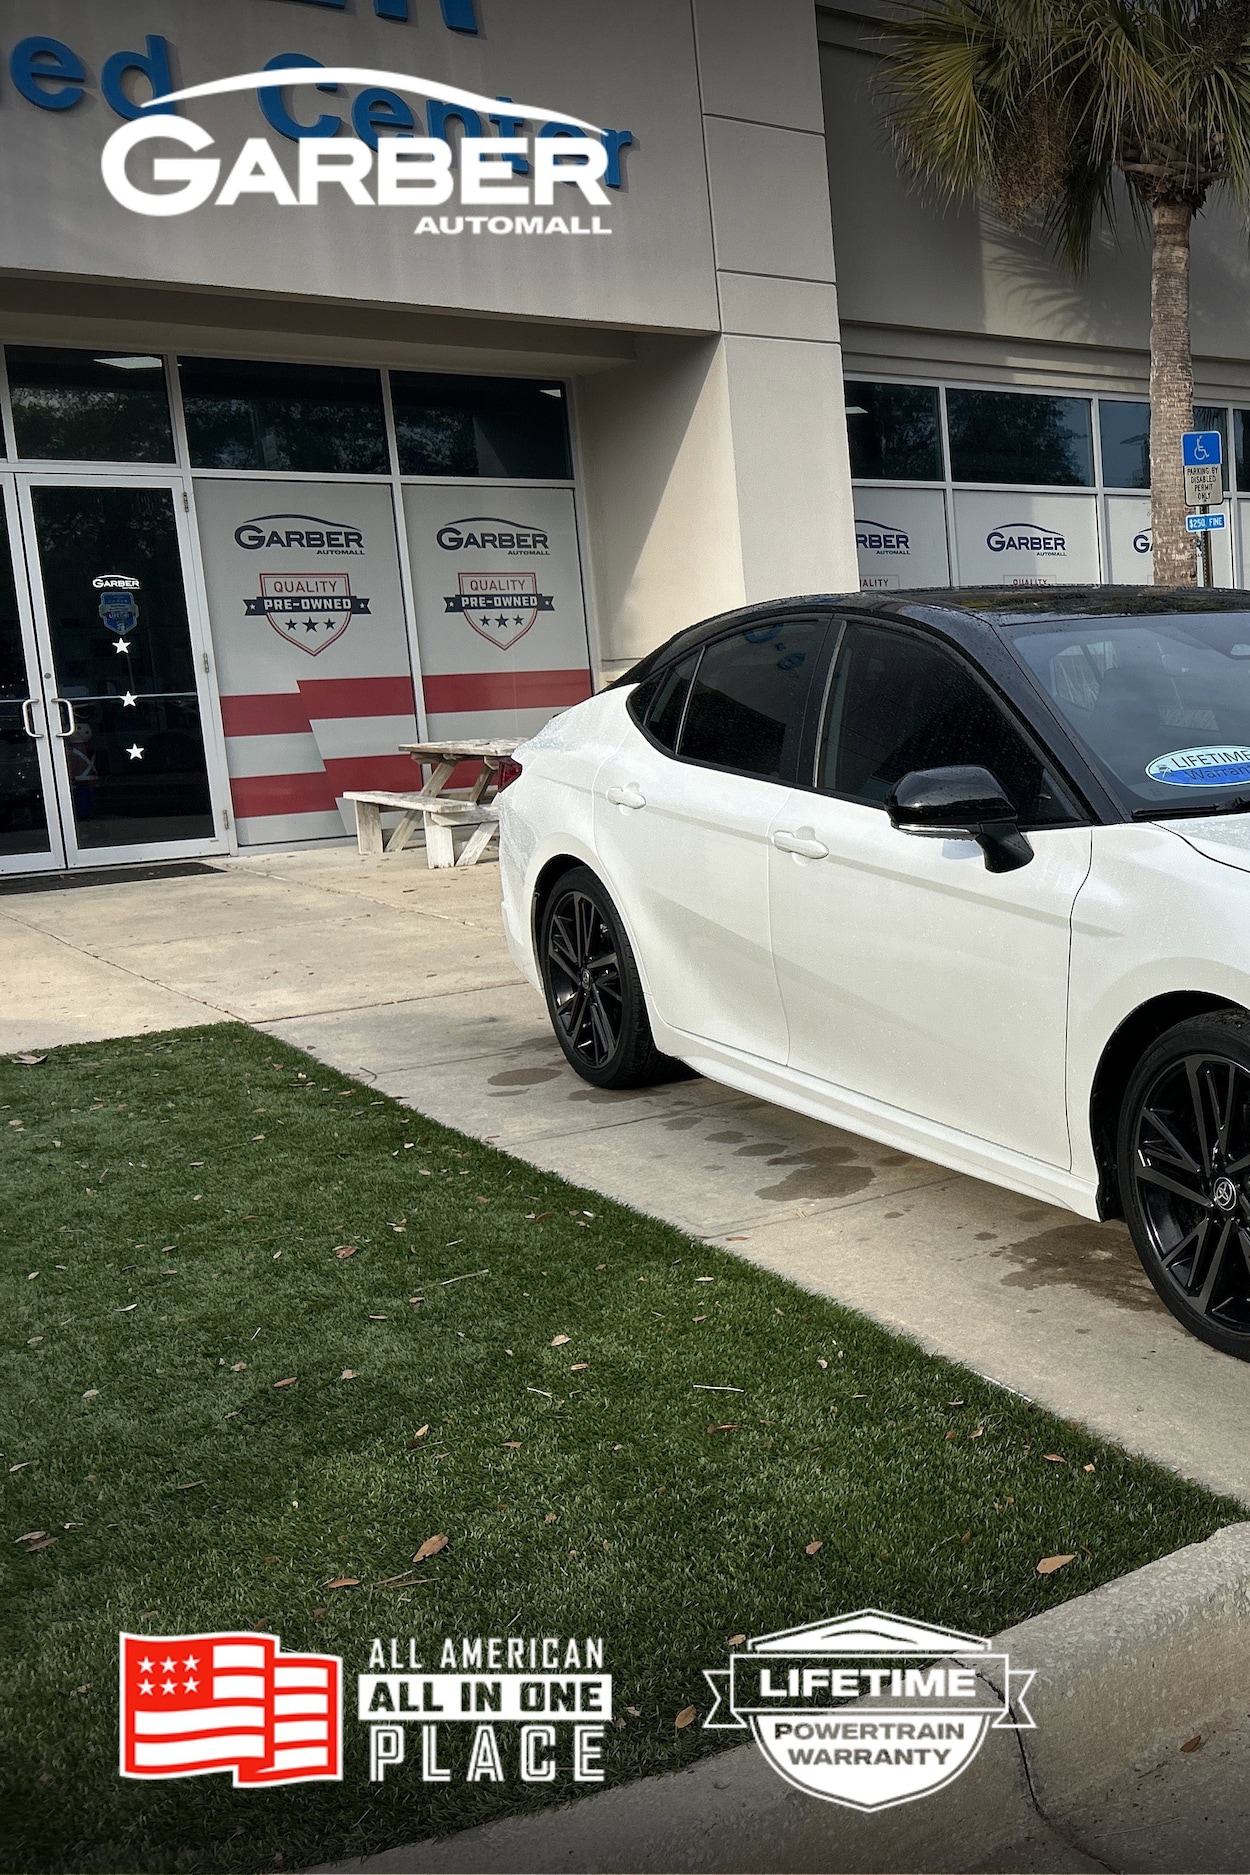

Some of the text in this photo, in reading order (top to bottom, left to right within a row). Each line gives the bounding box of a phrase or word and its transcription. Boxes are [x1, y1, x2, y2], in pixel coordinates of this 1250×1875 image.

[4, 36, 178, 122] ed
[1195, 484, 1213, 492] PERMIT
[1189, 517, 1223, 529] $250 FINE
[234, 525, 364, 550] GARBER
[437, 527, 549, 551] GARBER
[856, 534, 910, 549] RBER
[987, 532, 1066, 552] GARBER
[92, 579, 140, 588] GARBER
[274, 581, 337, 593] QUALITY
[470, 580, 525, 591] QUALITY
[860, 578, 889, 587] ALITY
[264, 599, 352, 610] PRE-OWNED
[461, 596, 538, 607] PRE-OWNED
